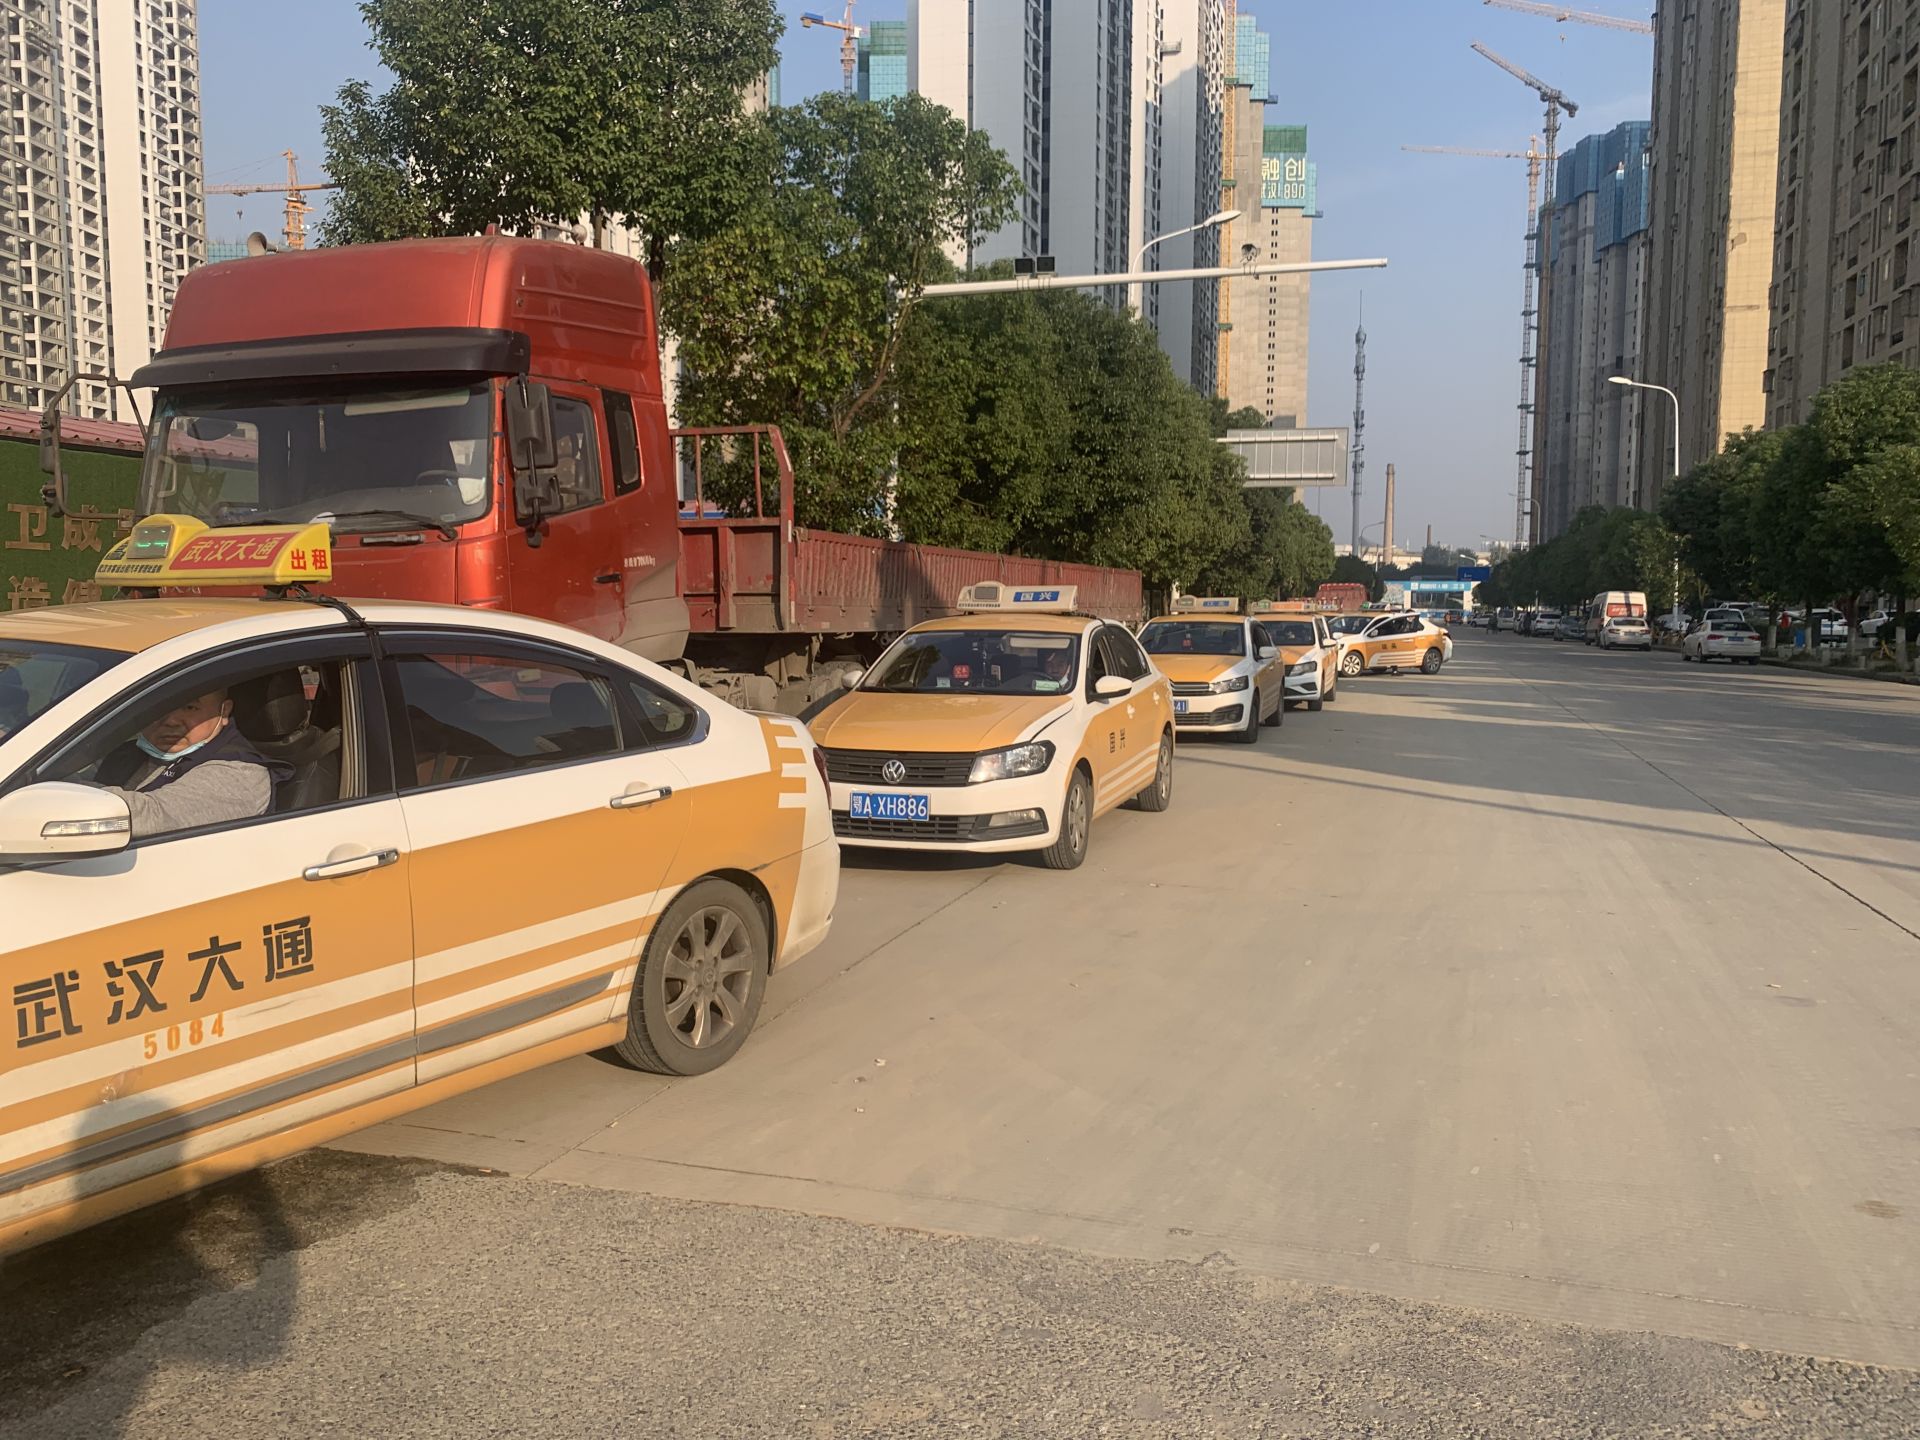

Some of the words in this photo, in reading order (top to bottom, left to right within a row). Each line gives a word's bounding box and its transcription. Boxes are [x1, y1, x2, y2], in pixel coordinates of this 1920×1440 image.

[1261, 157, 1305, 181] 融创
[181, 537, 286, 563] 武汉大通
[290, 548, 328, 570] 出租
[13, 915, 315, 1049] 武汉大通
[143, 1011, 225, 1061] 5084
